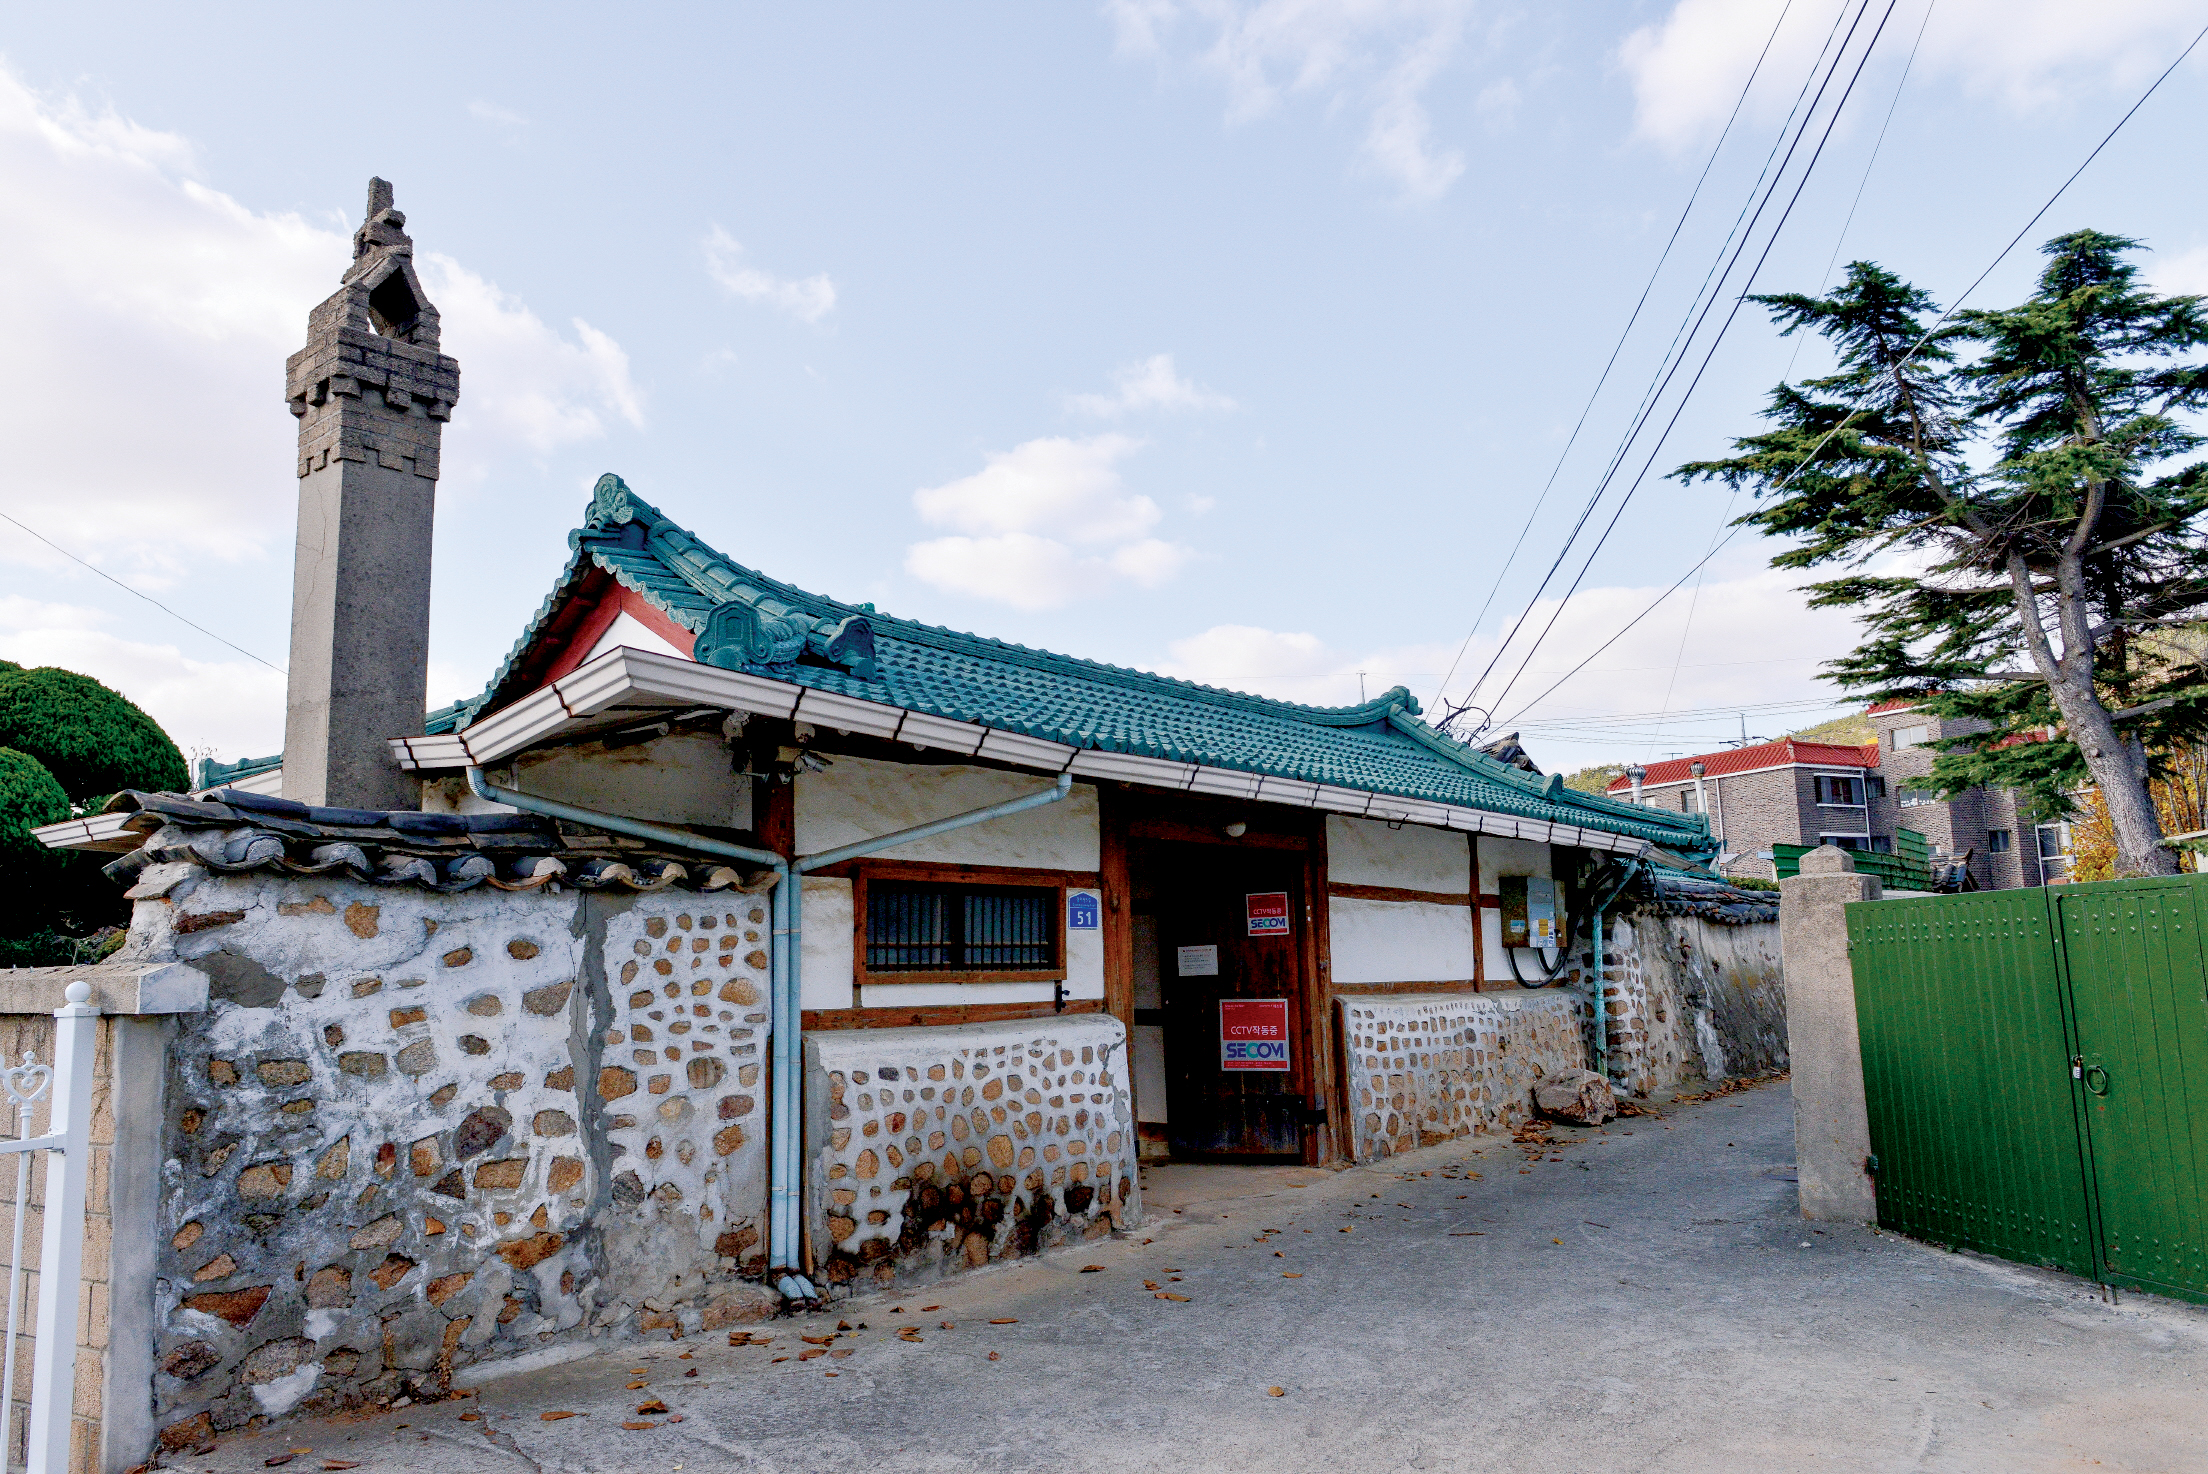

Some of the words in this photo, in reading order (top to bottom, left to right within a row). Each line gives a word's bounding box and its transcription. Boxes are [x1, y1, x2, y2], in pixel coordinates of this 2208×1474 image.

[1253, 907, 1282, 915] CCTV작동중
[1077, 910, 1092, 925] 51
[1250, 917, 1286, 929] SECOM
[1230, 1025, 1279, 1036] CCTV작동중
[1226, 1042, 1284, 1059] SECOM
